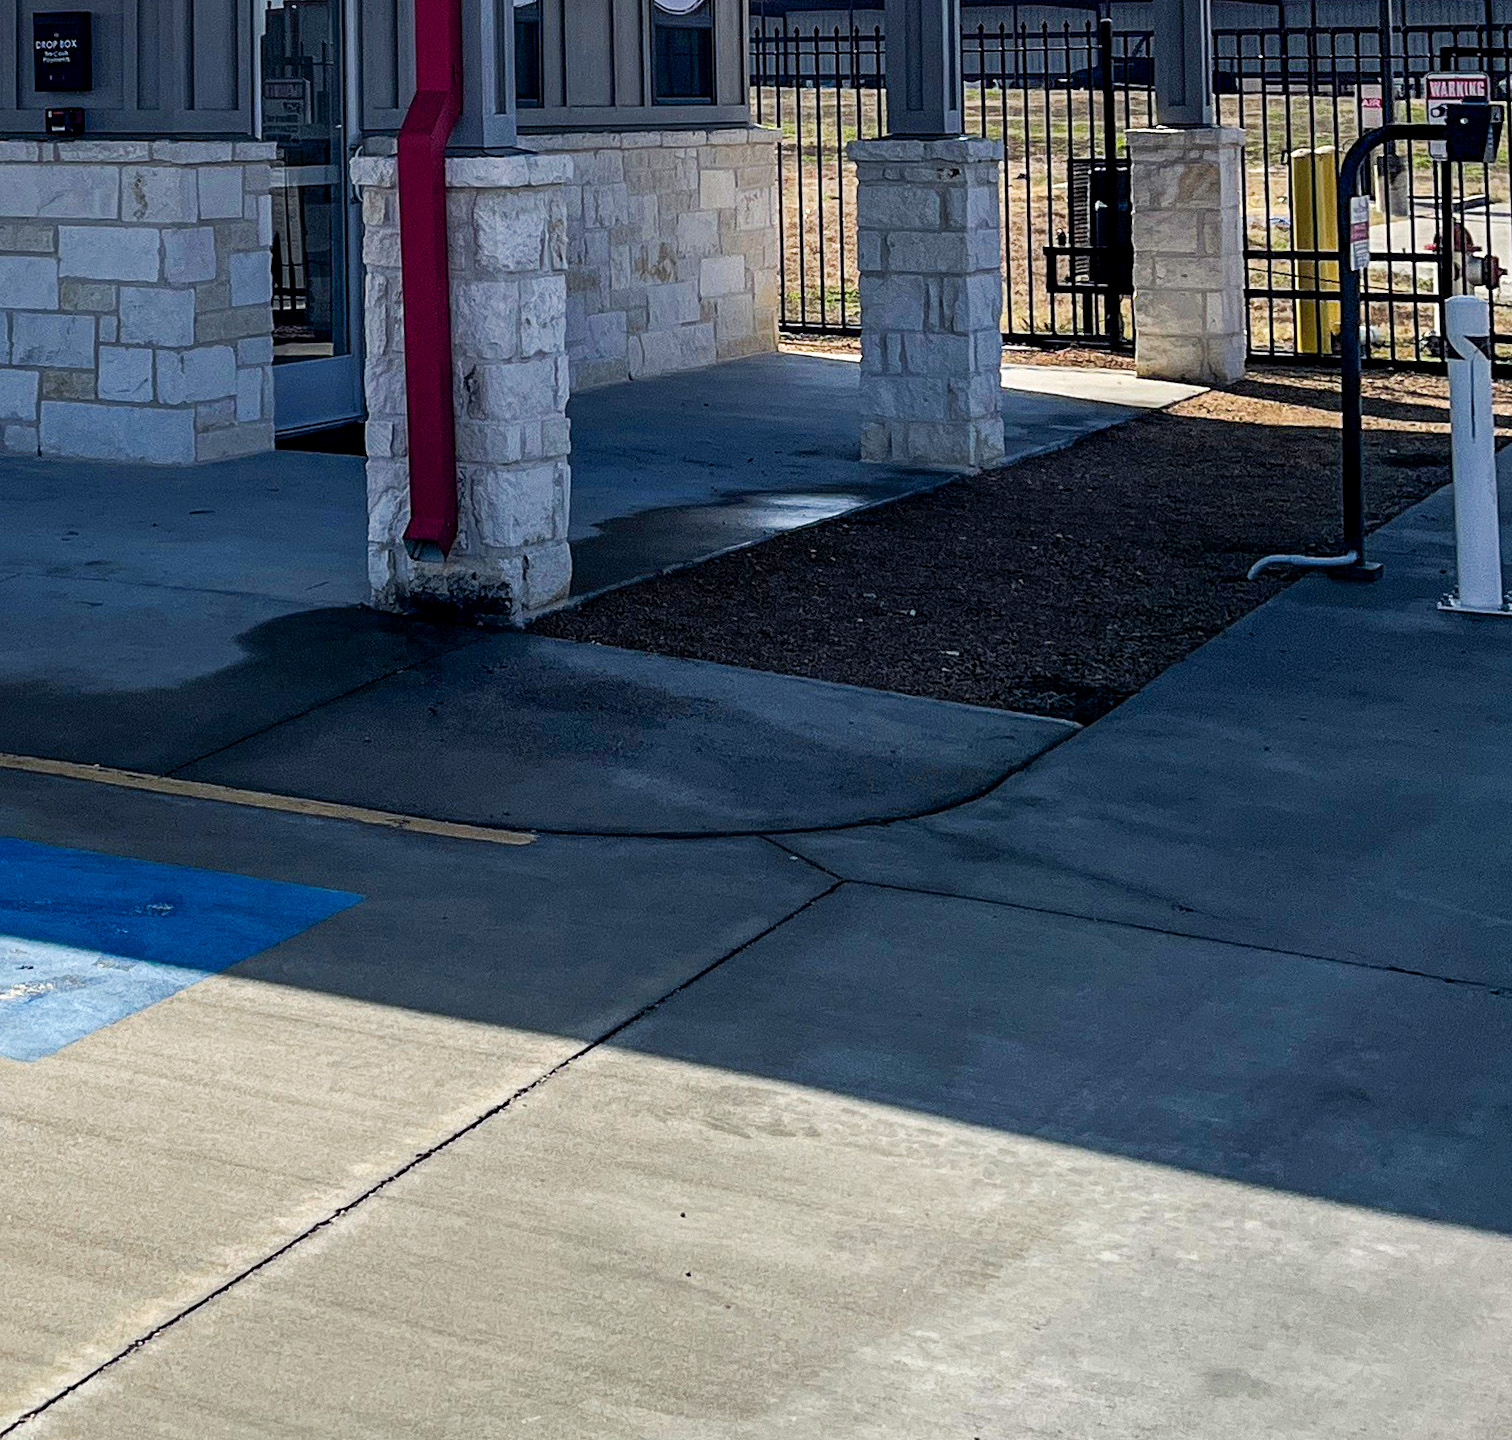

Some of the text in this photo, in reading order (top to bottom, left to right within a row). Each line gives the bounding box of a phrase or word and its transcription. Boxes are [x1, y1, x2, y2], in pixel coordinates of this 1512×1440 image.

[35, 40, 78, 50] DROP BOX
[1429, 81, 1486, 98] WARNING
